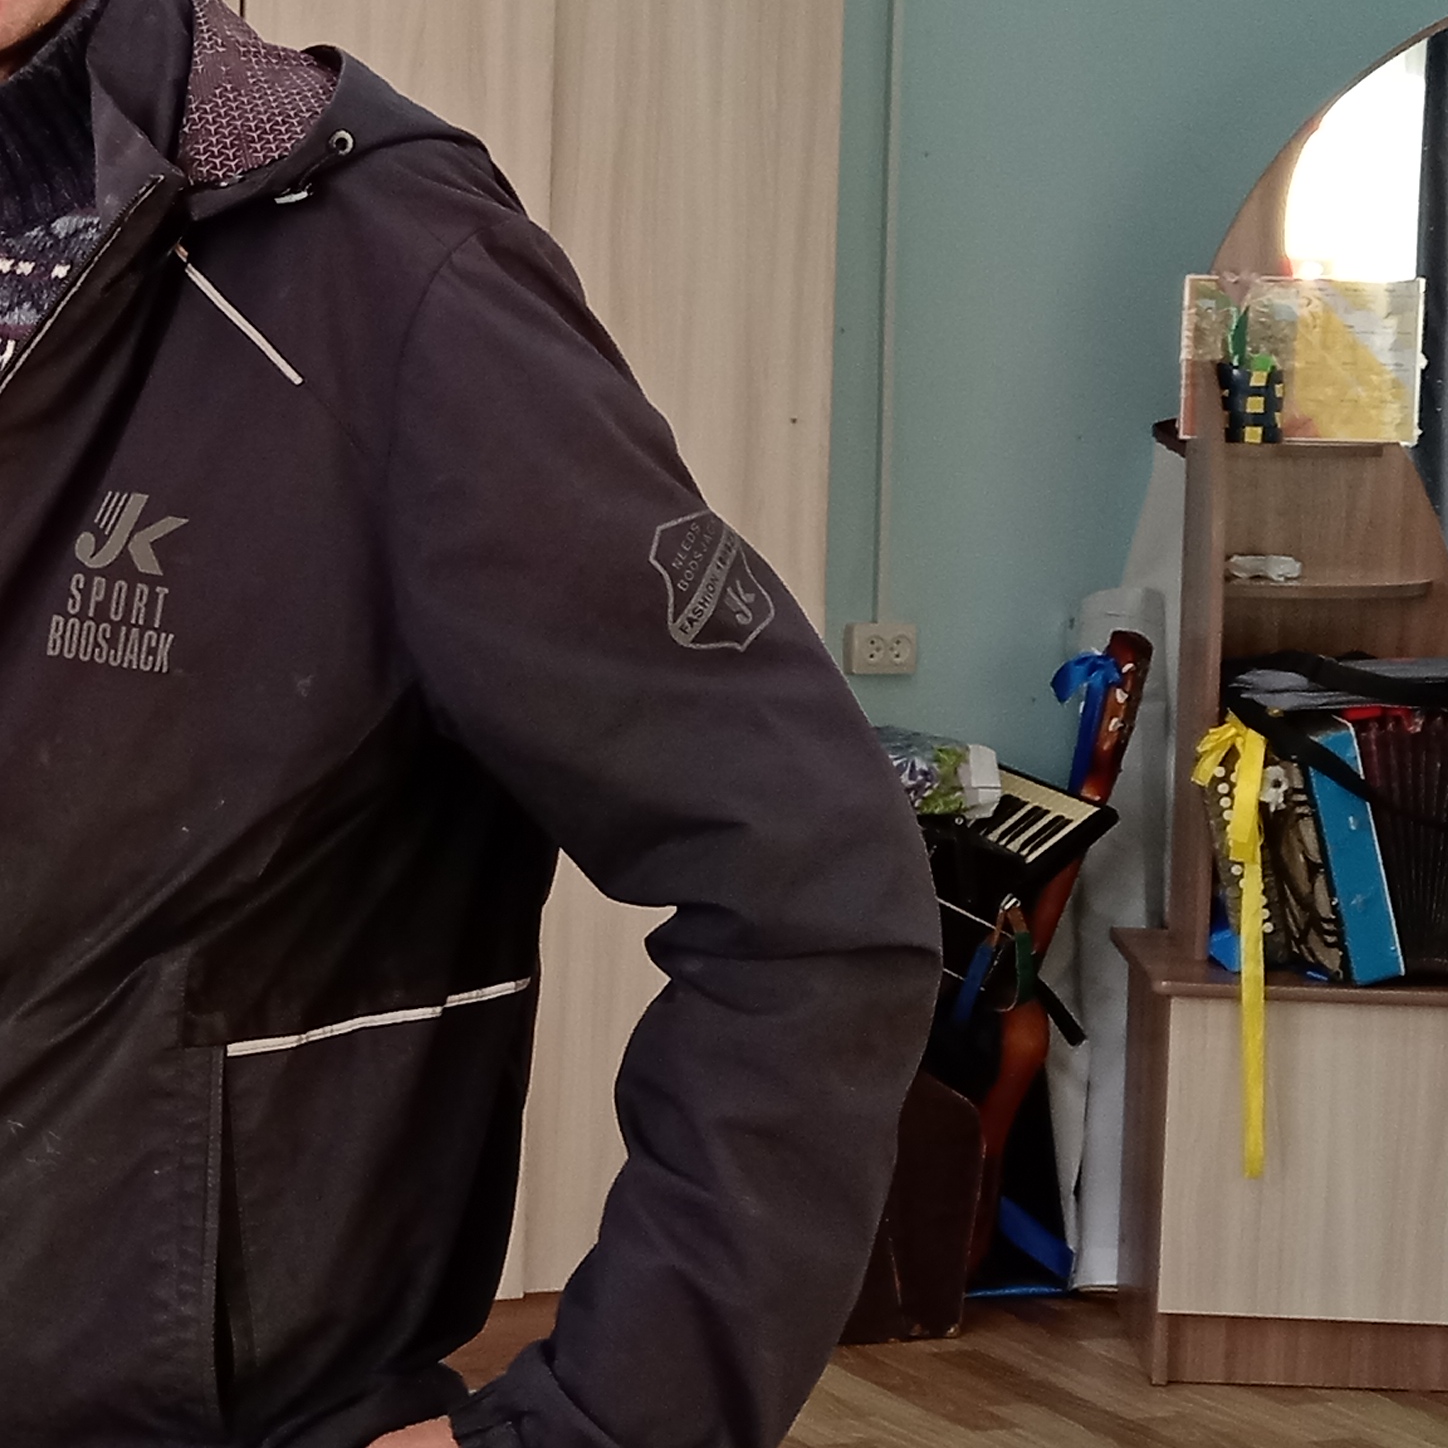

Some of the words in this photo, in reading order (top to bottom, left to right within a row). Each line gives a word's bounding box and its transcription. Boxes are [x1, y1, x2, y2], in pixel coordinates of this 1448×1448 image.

[67, 573, 170, 628] SPORT
[678, 576, 719, 635] FASHION
[46, 614, 175, 674] BOOSJACK
